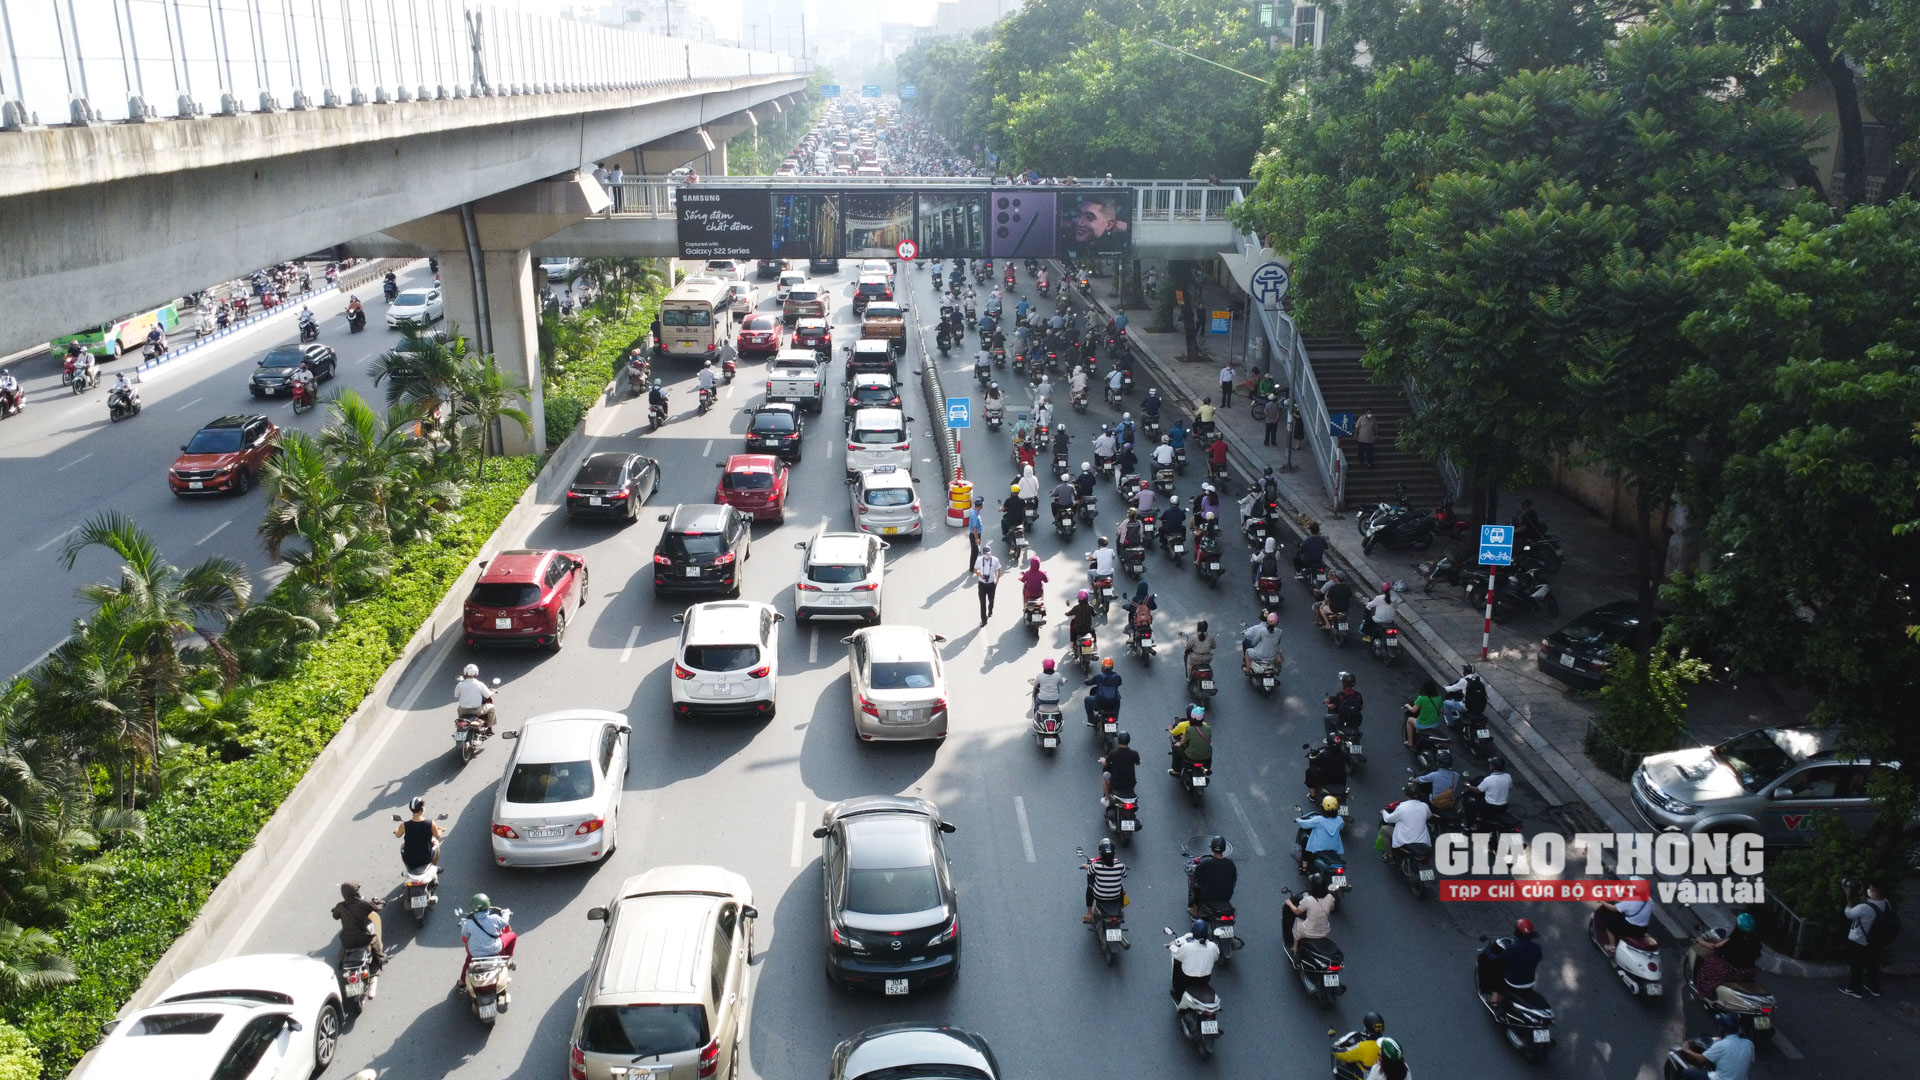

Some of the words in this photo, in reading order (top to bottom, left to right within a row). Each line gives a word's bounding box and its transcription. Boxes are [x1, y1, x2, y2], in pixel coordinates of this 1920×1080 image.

[682, 194, 721, 202] SAMSUNG
[684, 209, 708, 224] Sống
[709, 210, 734, 223] đậm
[706, 220, 730, 232] chất
[685, 247, 713, 256] Galaxy
[713, 247, 726, 255] S22
[727, 247, 751, 255] Series
